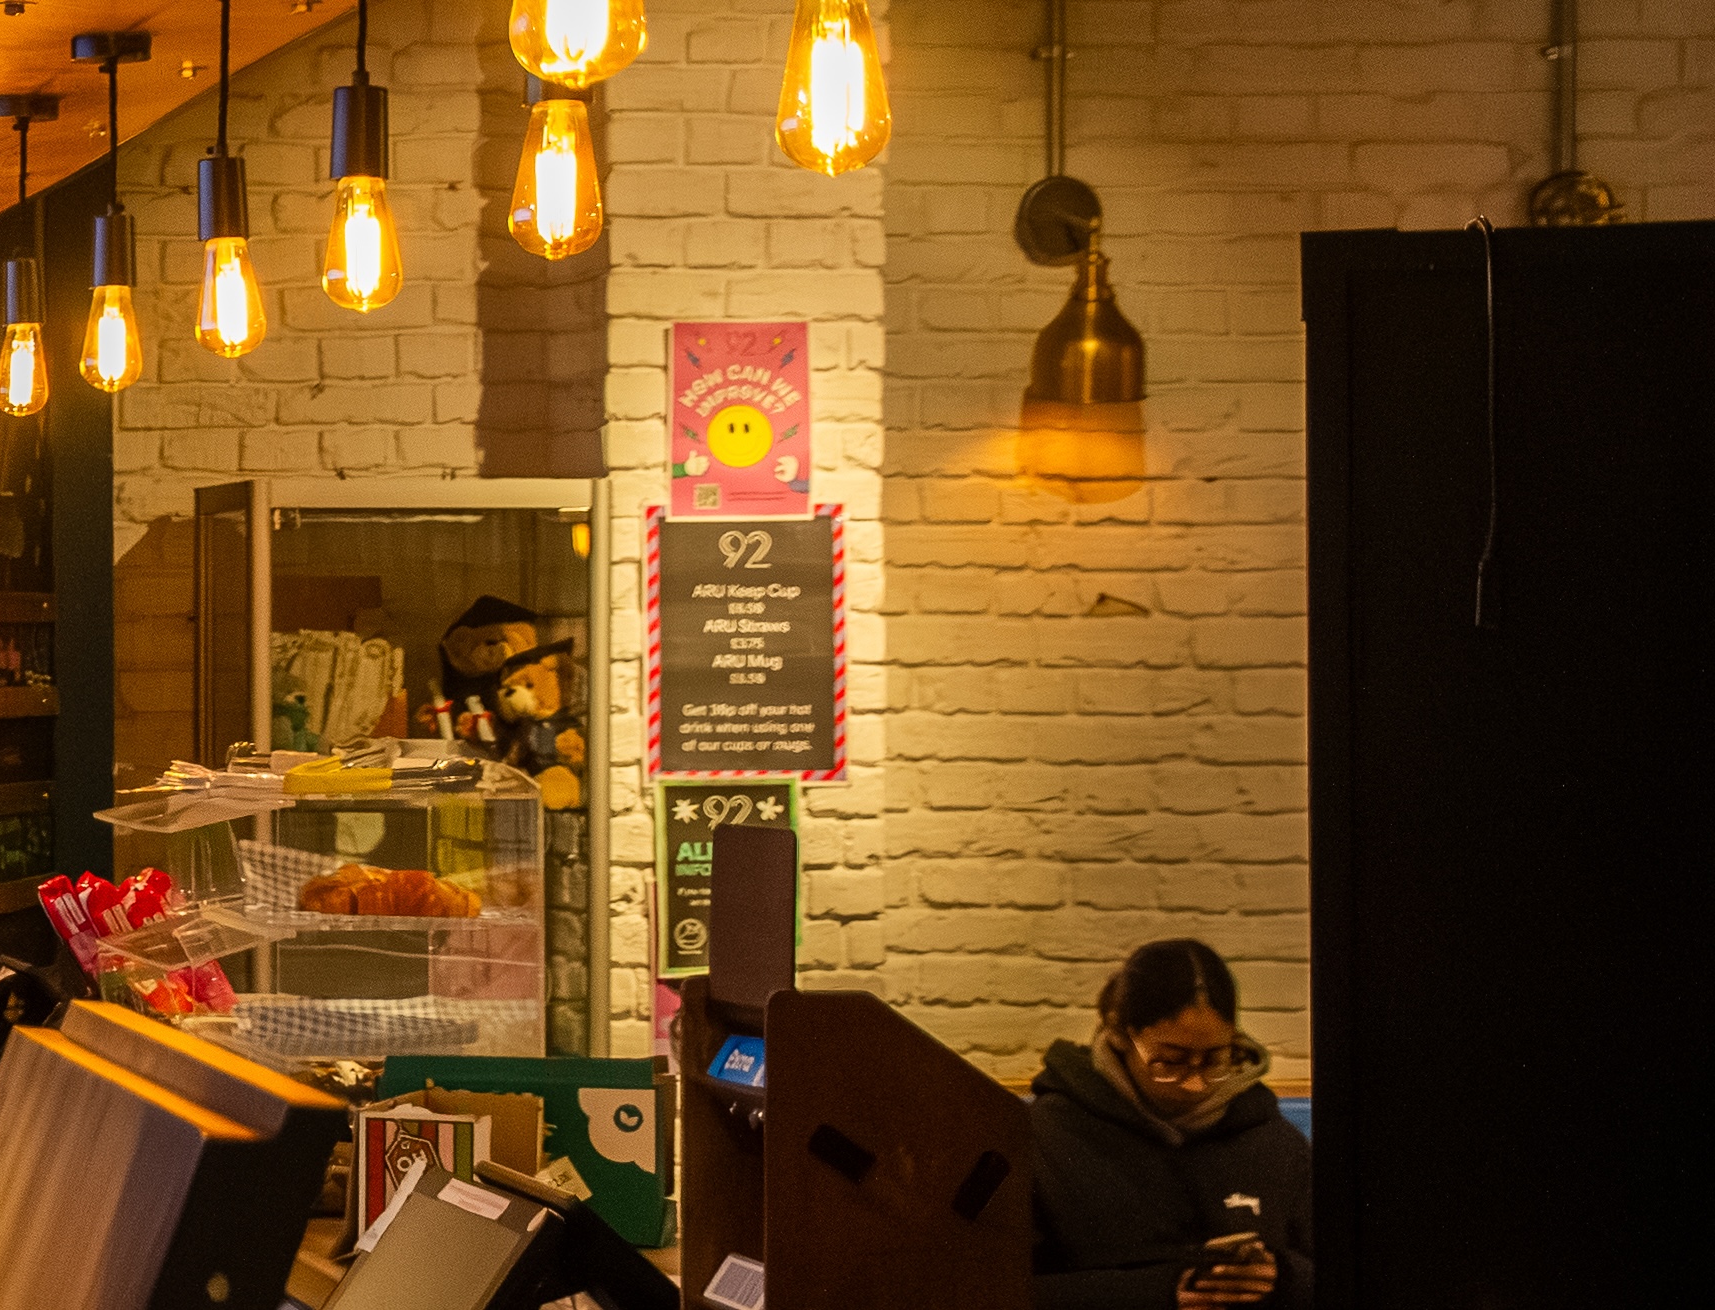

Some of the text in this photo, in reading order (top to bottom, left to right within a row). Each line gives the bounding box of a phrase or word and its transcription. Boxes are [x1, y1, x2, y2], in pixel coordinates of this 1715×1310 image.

[678, 364, 802, 408] HOW CAN WE
[695, 385, 786, 417] IMPROVE?
[718, 530, 773, 569] 92
[691, 583, 801, 600] ARU Keep Cup
[703, 619, 791, 633] ARU Straws
[712, 654, 783, 671] ARU Mug
[738, 703, 758, 716] off
[759, 705, 788, 717] your
[679, 721, 815, 735] drink when using one
[681, 739, 697, 751] of
[698, 741, 721, 751] our
[722, 741, 755, 753] cups
[755, 741, 772, 751] or
[703, 794, 754, 831] 92
